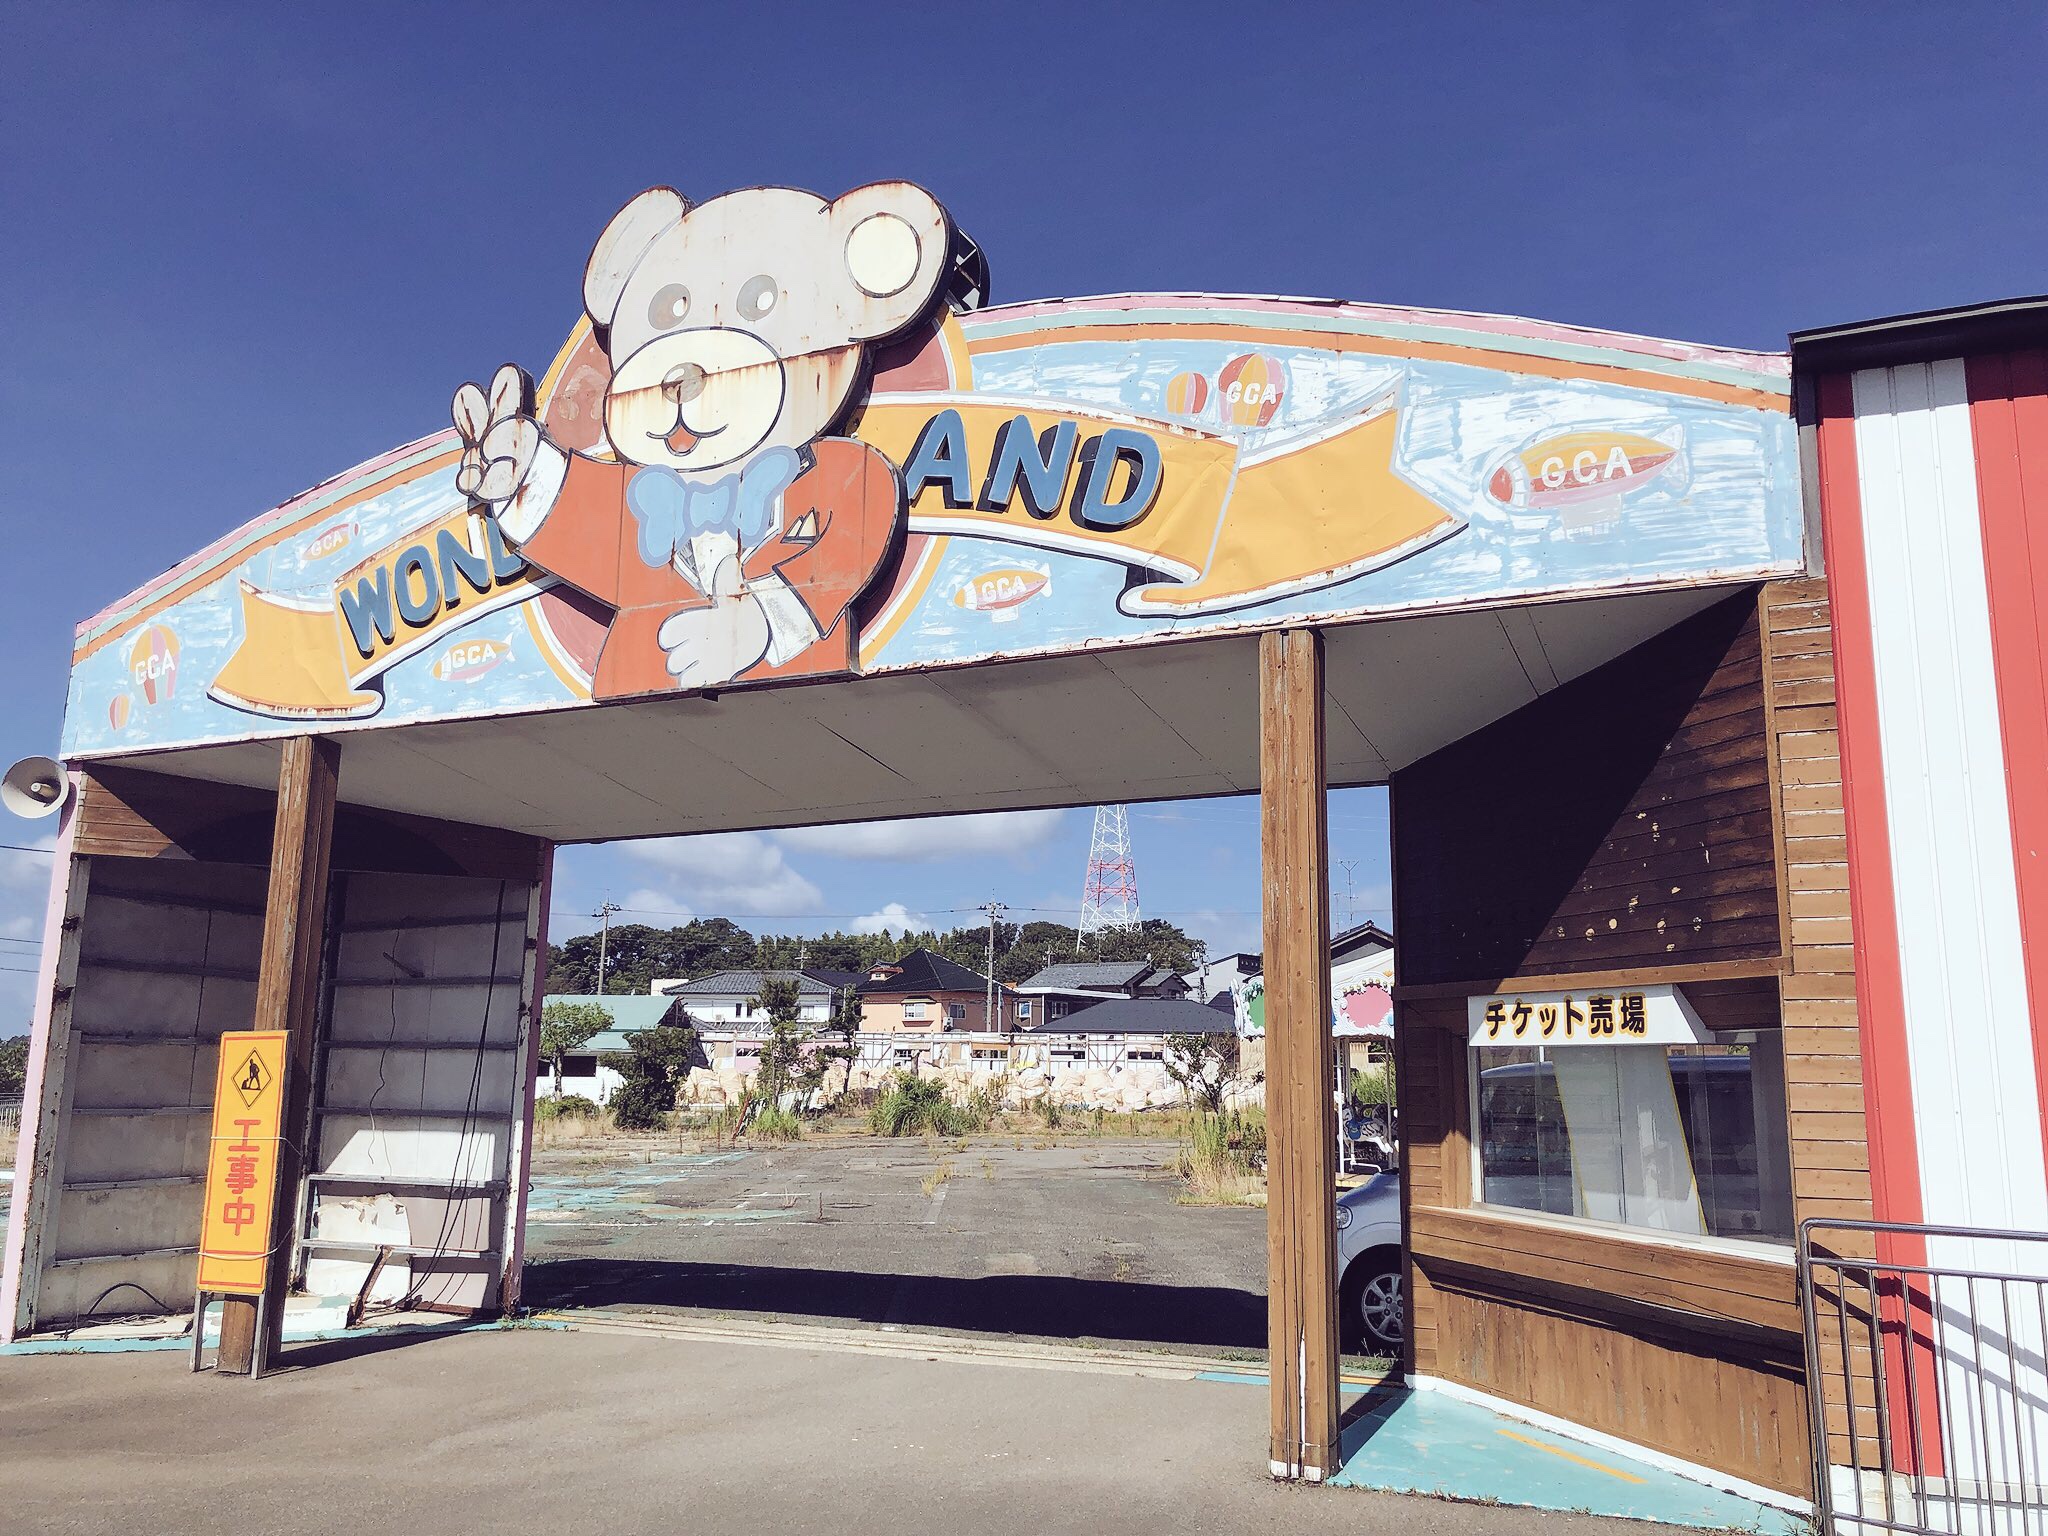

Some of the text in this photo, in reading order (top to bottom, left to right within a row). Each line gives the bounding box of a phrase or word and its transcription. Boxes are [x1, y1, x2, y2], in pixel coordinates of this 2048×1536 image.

[1226, 381, 1277, 405] GCA
[905, 409, 1162, 529] AND
[1541, 446, 1634, 487] GCA
[311, 530, 343, 556] GCA
[981, 576, 1027, 602] GCA
[135, 648, 176, 685] GCA
[452, 643, 497, 668] GCA
[1486, 995, 1646, 1036] チケット売場
[224, 1119, 262, 1236] 工事中
